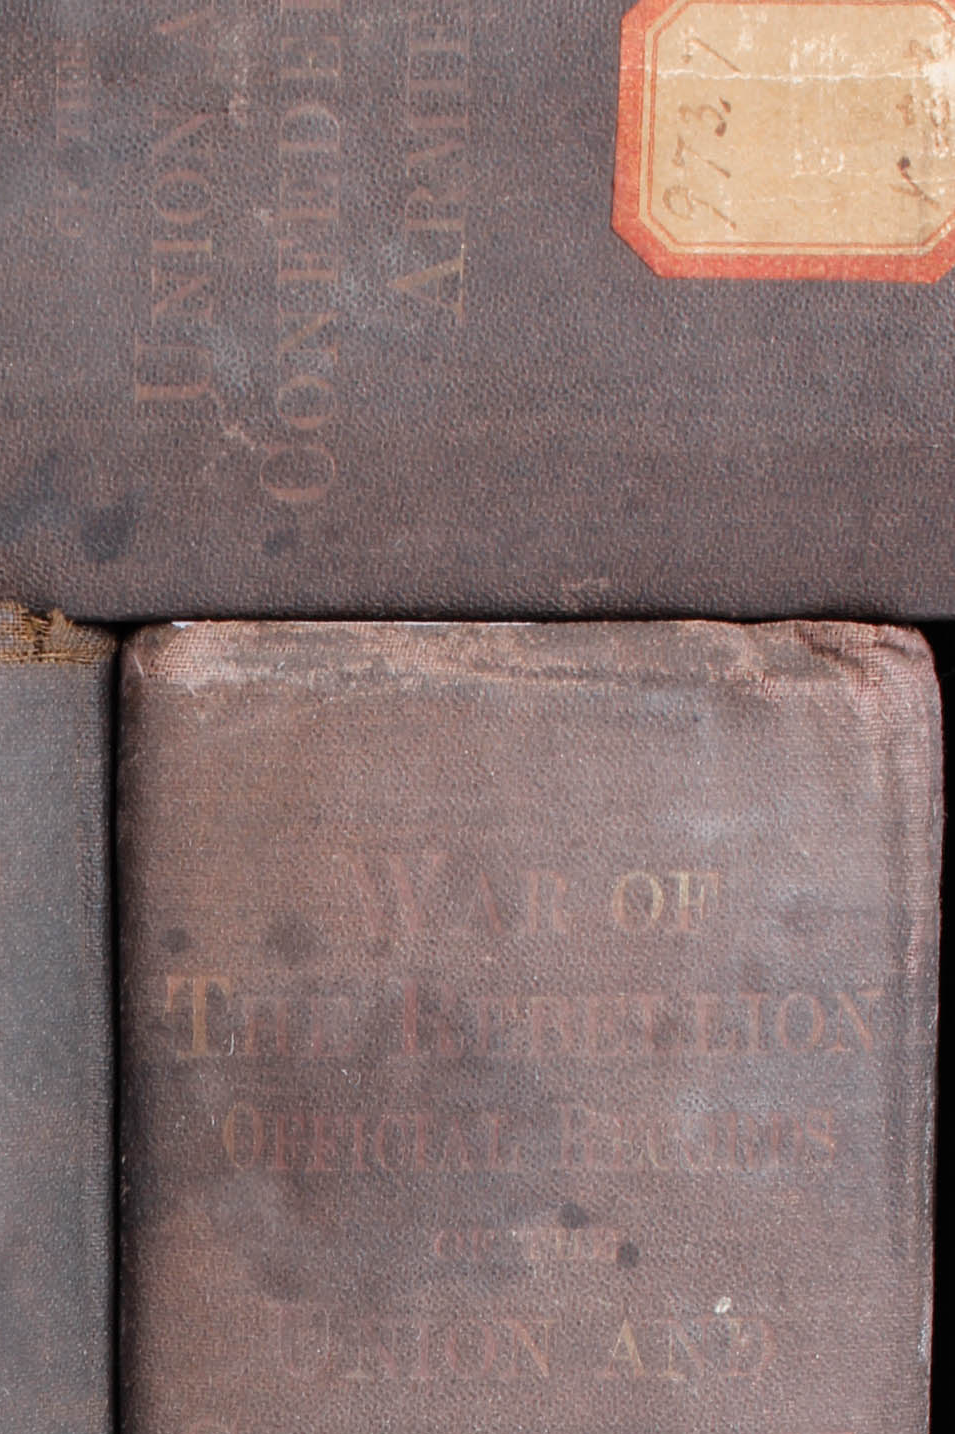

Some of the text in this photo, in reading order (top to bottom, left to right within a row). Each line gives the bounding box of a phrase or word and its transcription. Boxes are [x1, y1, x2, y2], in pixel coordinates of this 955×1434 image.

[259, 0, 343, 504] CONFEDE
[385, 0, 471, 326] ARMIE
[133, 108, 214, 404] UNION
[610, 868, 721, 937] OF
[220, 1101, 525, 1173] OFFICIAL
[604, 1316, 779, 1382] AND
